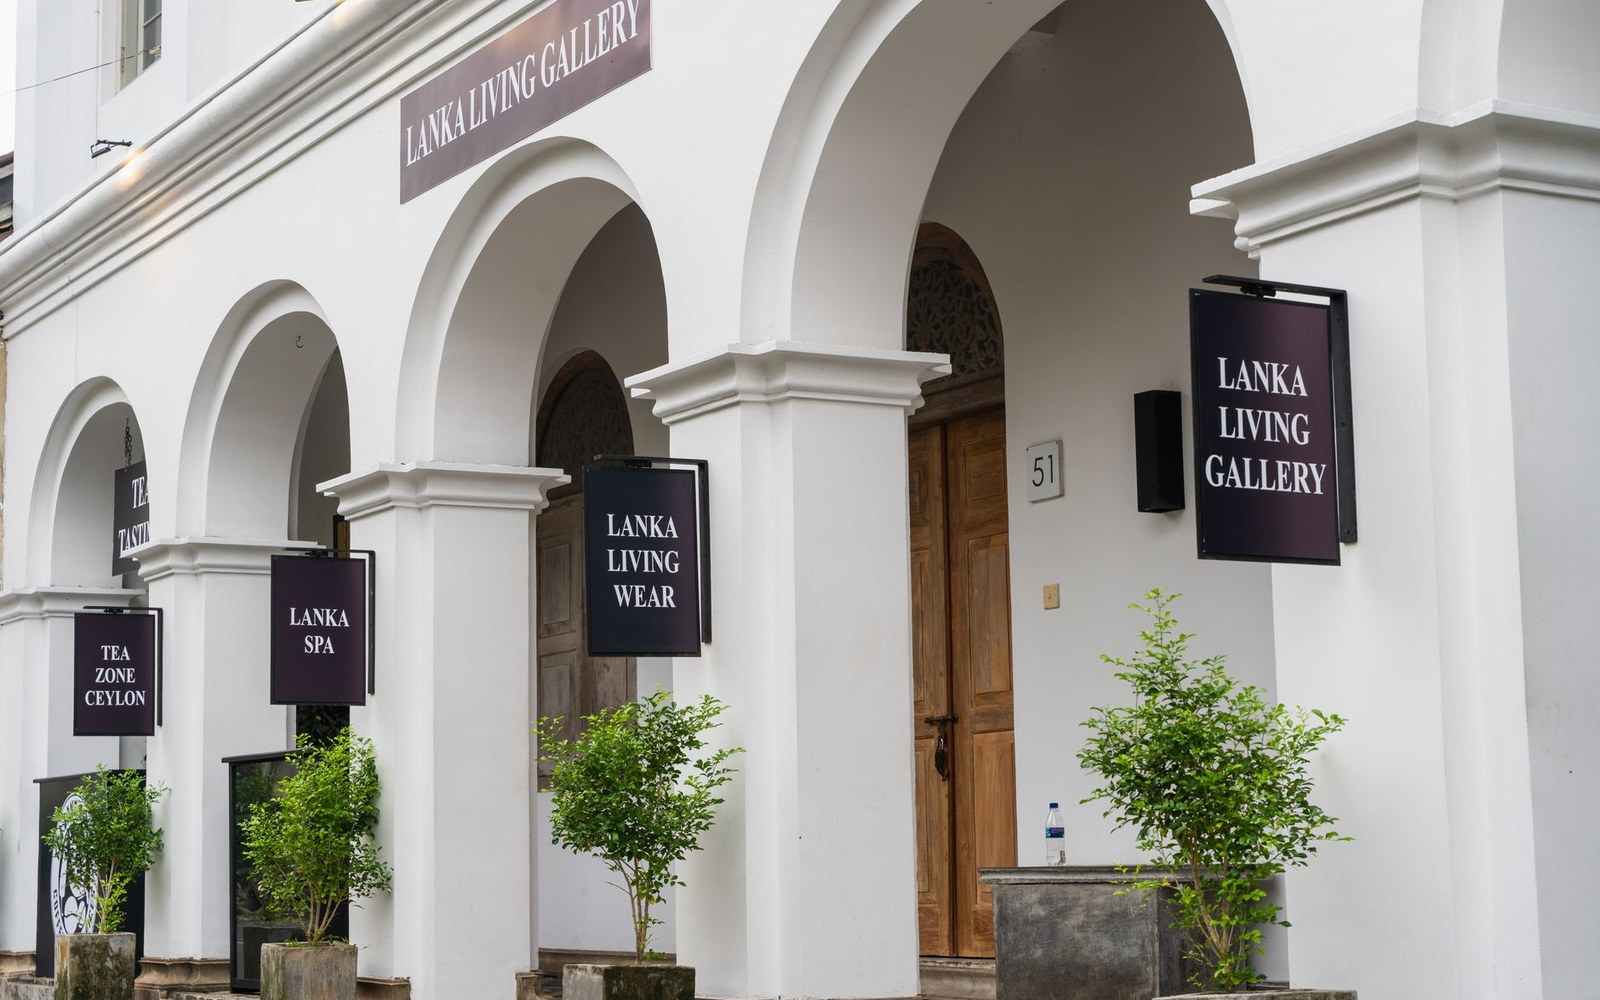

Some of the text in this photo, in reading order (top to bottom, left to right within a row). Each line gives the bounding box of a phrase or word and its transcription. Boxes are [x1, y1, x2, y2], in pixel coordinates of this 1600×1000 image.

[405, 0, 640, 167] LANKA LIVING GALLERY
[1217, 356, 1309, 397] LANKA
[1218, 406, 1311, 446] LIVING
[1032, 454, 1054, 488] 51
[1205, 454, 1327, 495] GALLERY
[606, 513, 679, 539] LANKA
[607, 549, 680, 574] LIVING
[613, 584, 676, 608] WEAR
[289, 607, 350, 627] LANKA
[100, 645, 131, 661] TEA
[304, 634, 335, 654] SPA
[95, 667, 136, 684] ZONE
[84, 689, 146, 706] CEYLON
